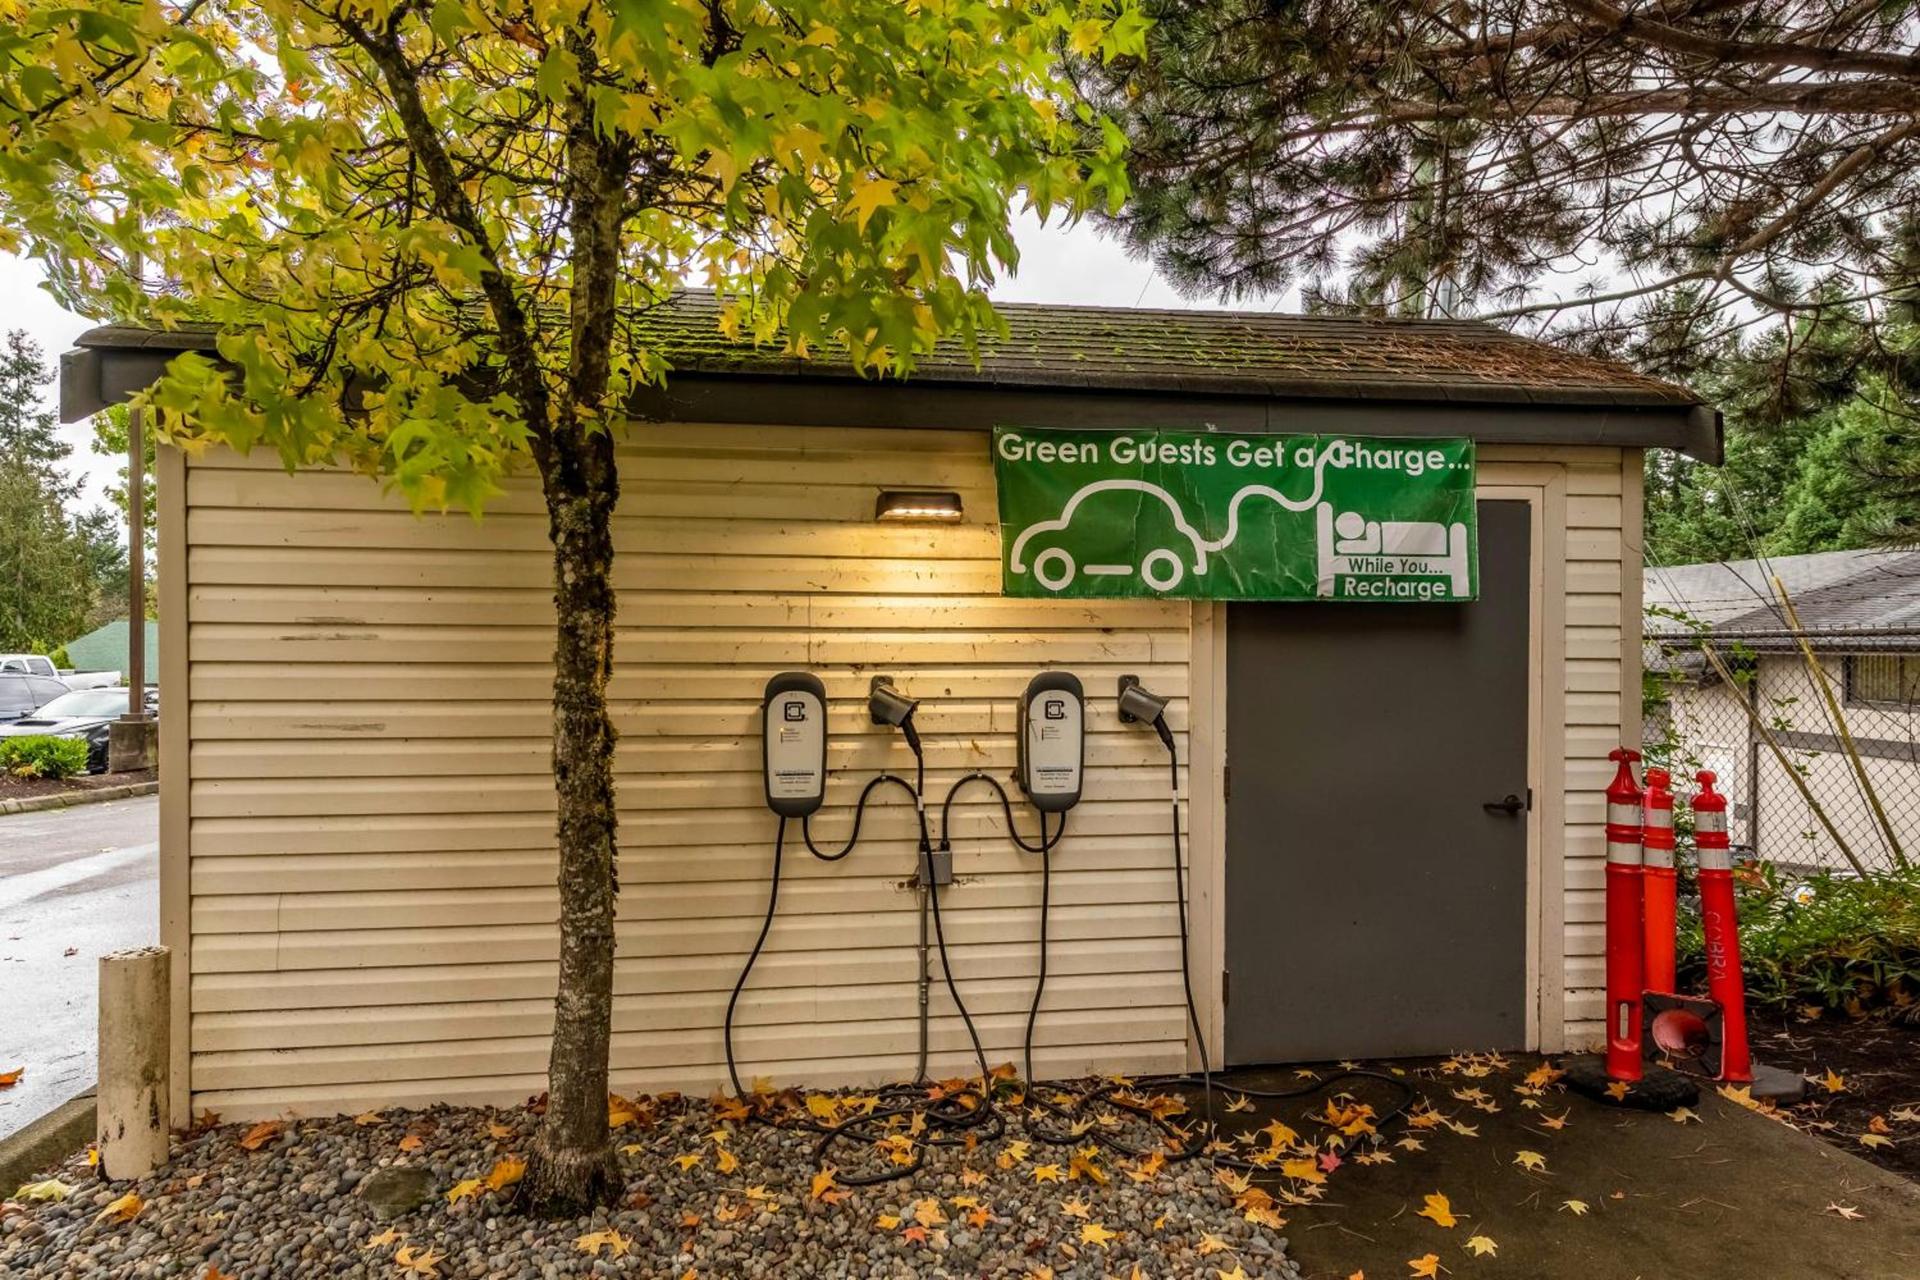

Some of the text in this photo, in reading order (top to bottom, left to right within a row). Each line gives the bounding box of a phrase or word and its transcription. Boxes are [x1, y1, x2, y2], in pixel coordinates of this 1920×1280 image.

[998, 433, 1098, 463] Green
[1109, 436, 1216, 466] Guests
[1226, 440, 1285, 468] Get
[1294, 447, 1314, 468] a
[1348, 558, 1443, 574] While You...
[1344, 577, 1446, 600] Recharge
[1706, 910, 1727, 981] COBRA
